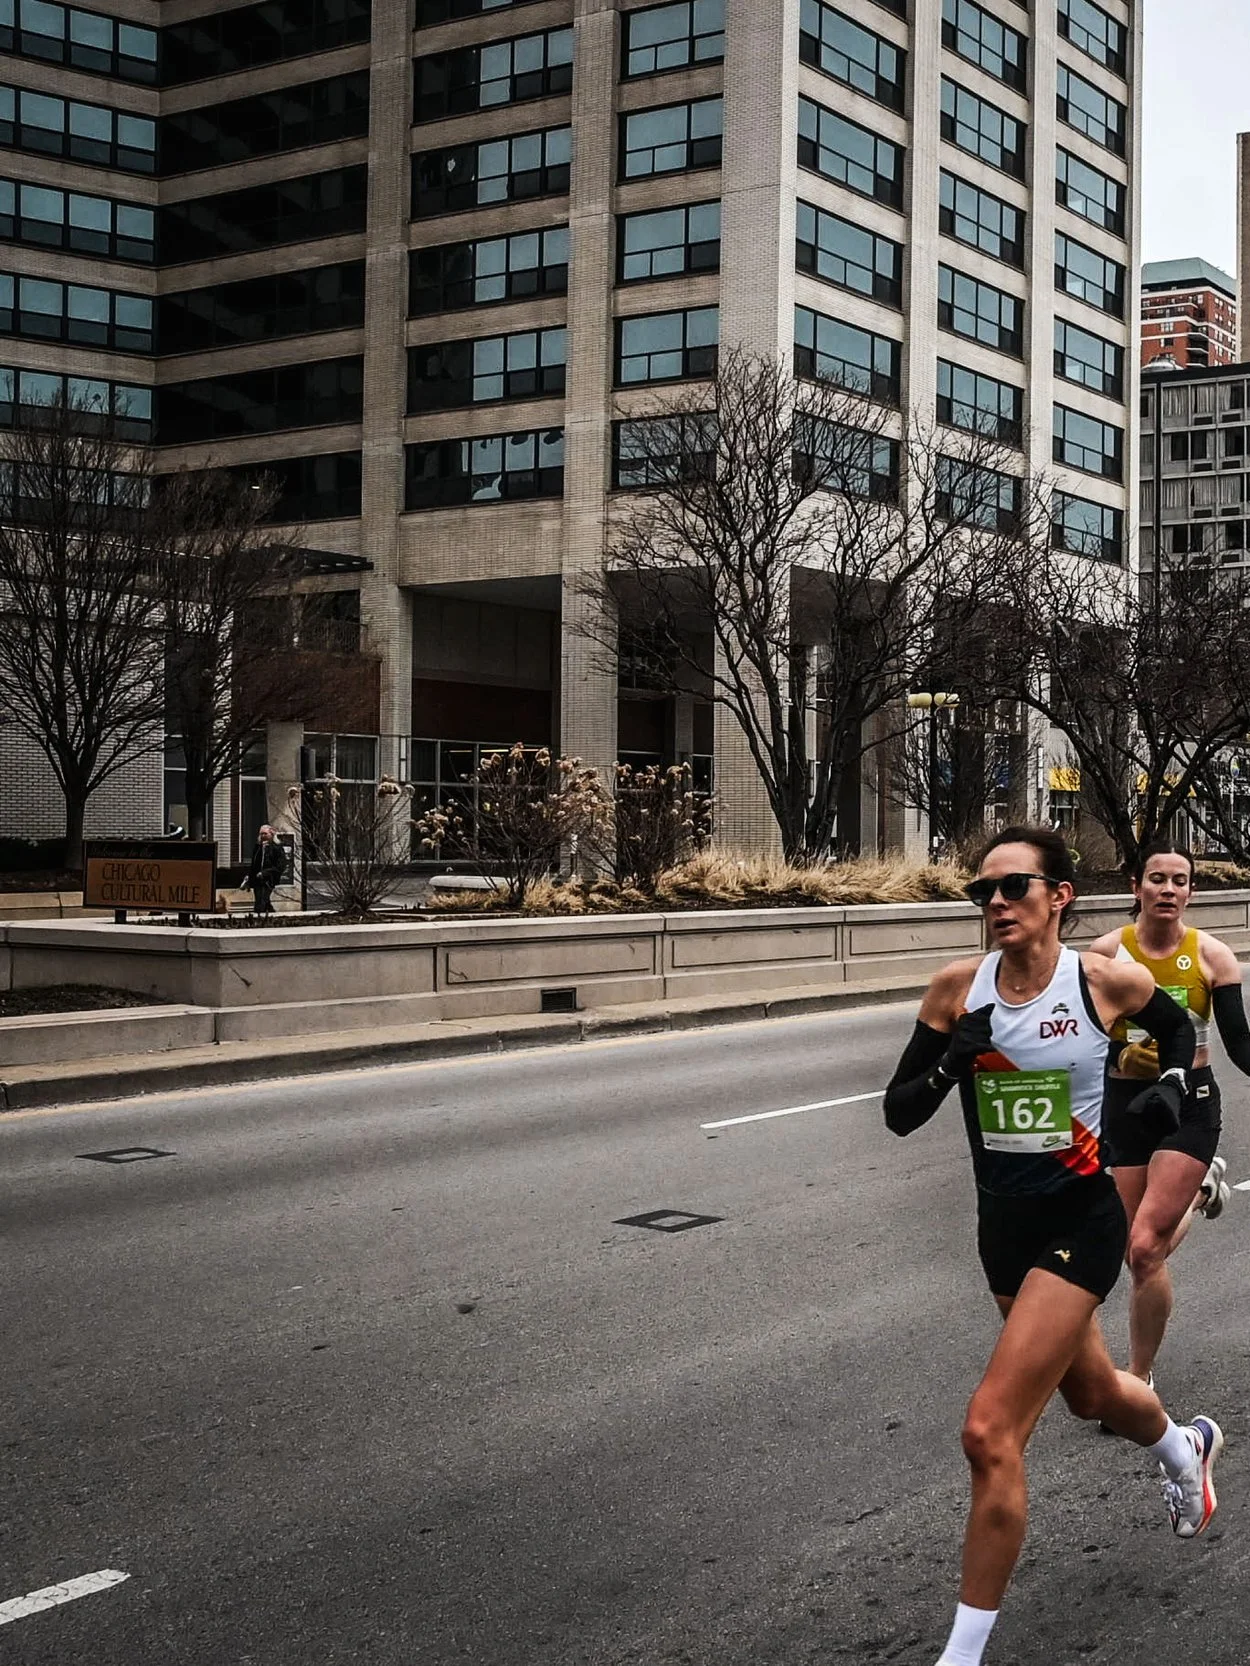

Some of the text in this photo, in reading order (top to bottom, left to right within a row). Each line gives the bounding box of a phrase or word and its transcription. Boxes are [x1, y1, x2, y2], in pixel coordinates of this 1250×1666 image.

[102, 862, 160, 882] CHICAGO
[102, 882, 200, 904] CULTURAL MILE
[992, 1097, 1056, 1130] 162
